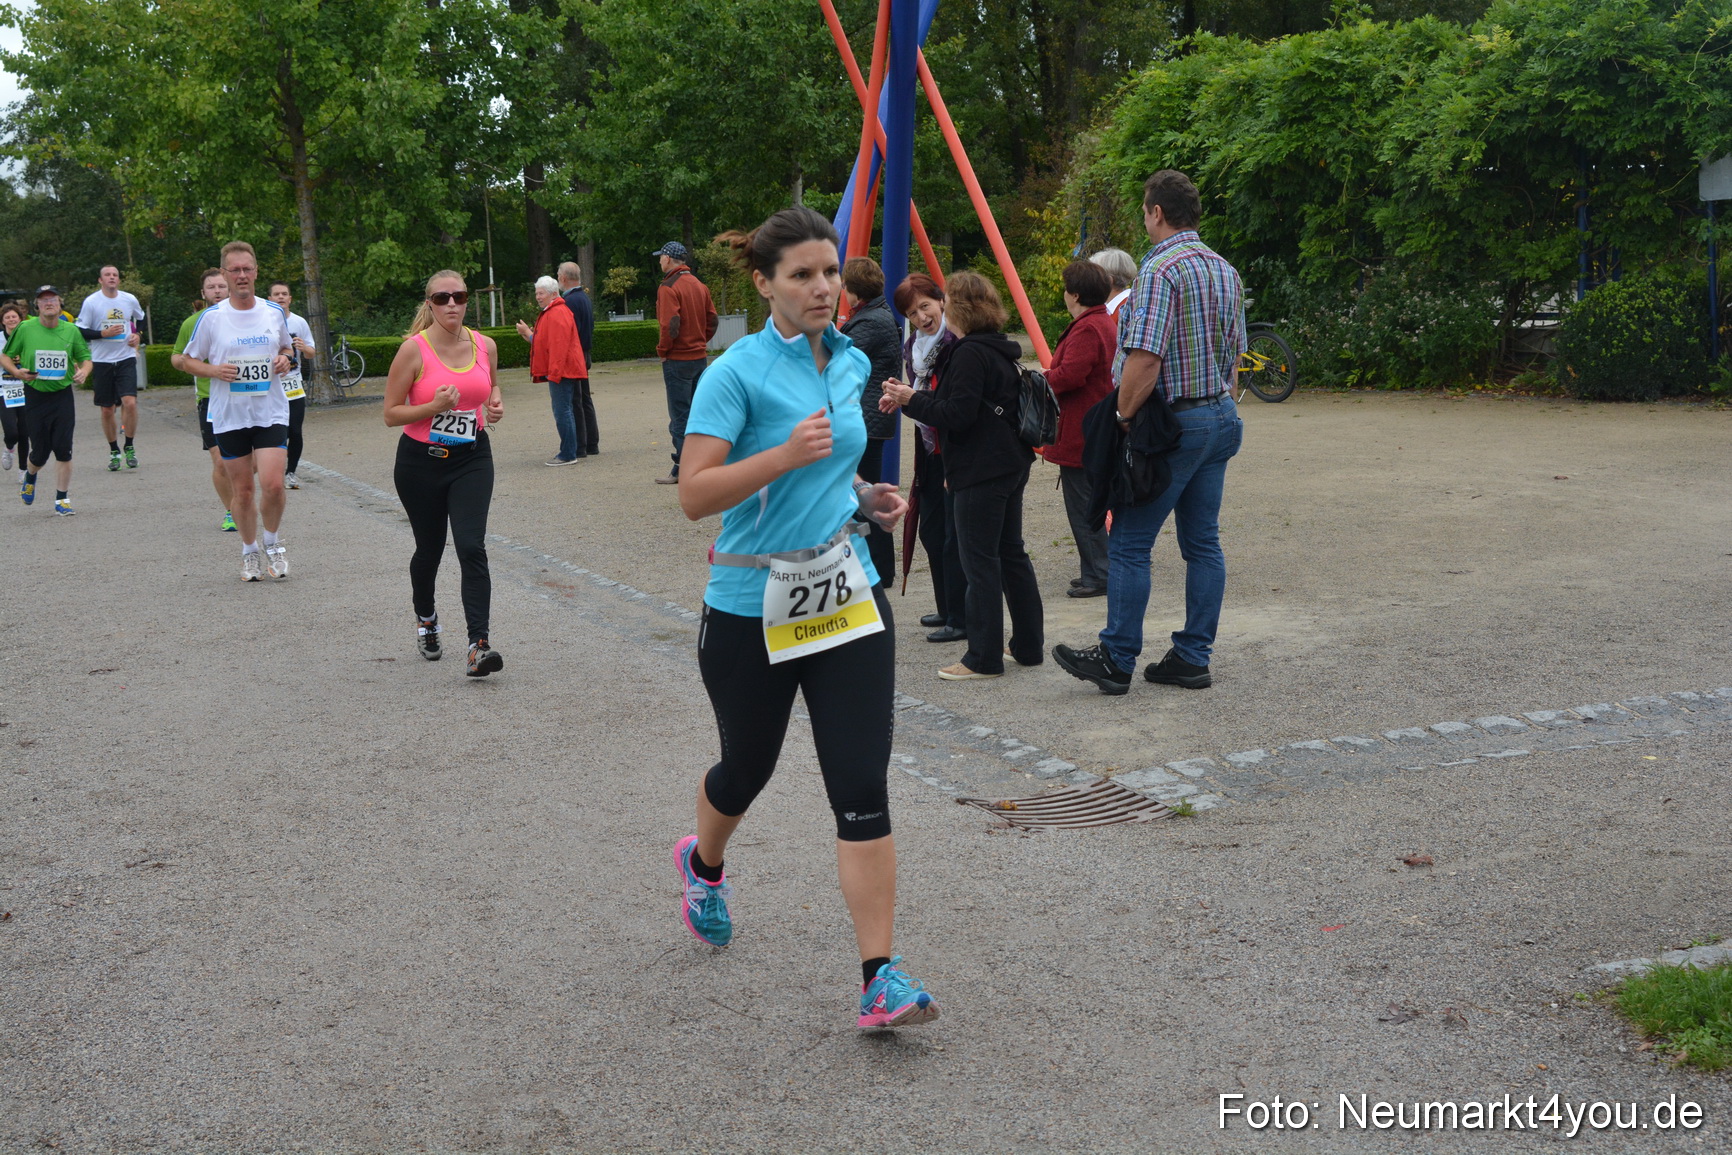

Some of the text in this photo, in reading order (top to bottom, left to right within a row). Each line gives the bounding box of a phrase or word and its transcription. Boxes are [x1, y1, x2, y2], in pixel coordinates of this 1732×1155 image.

[237, 335, 269, 345] heinloth
[39, 357, 66, 369] 3364
[281, 379, 299, 392] 219
[431, 414, 477, 437] 2251
[770, 570, 806, 582] PARTL
[788, 570, 852, 618] 278
[794, 616, 849, 641] Claudia
